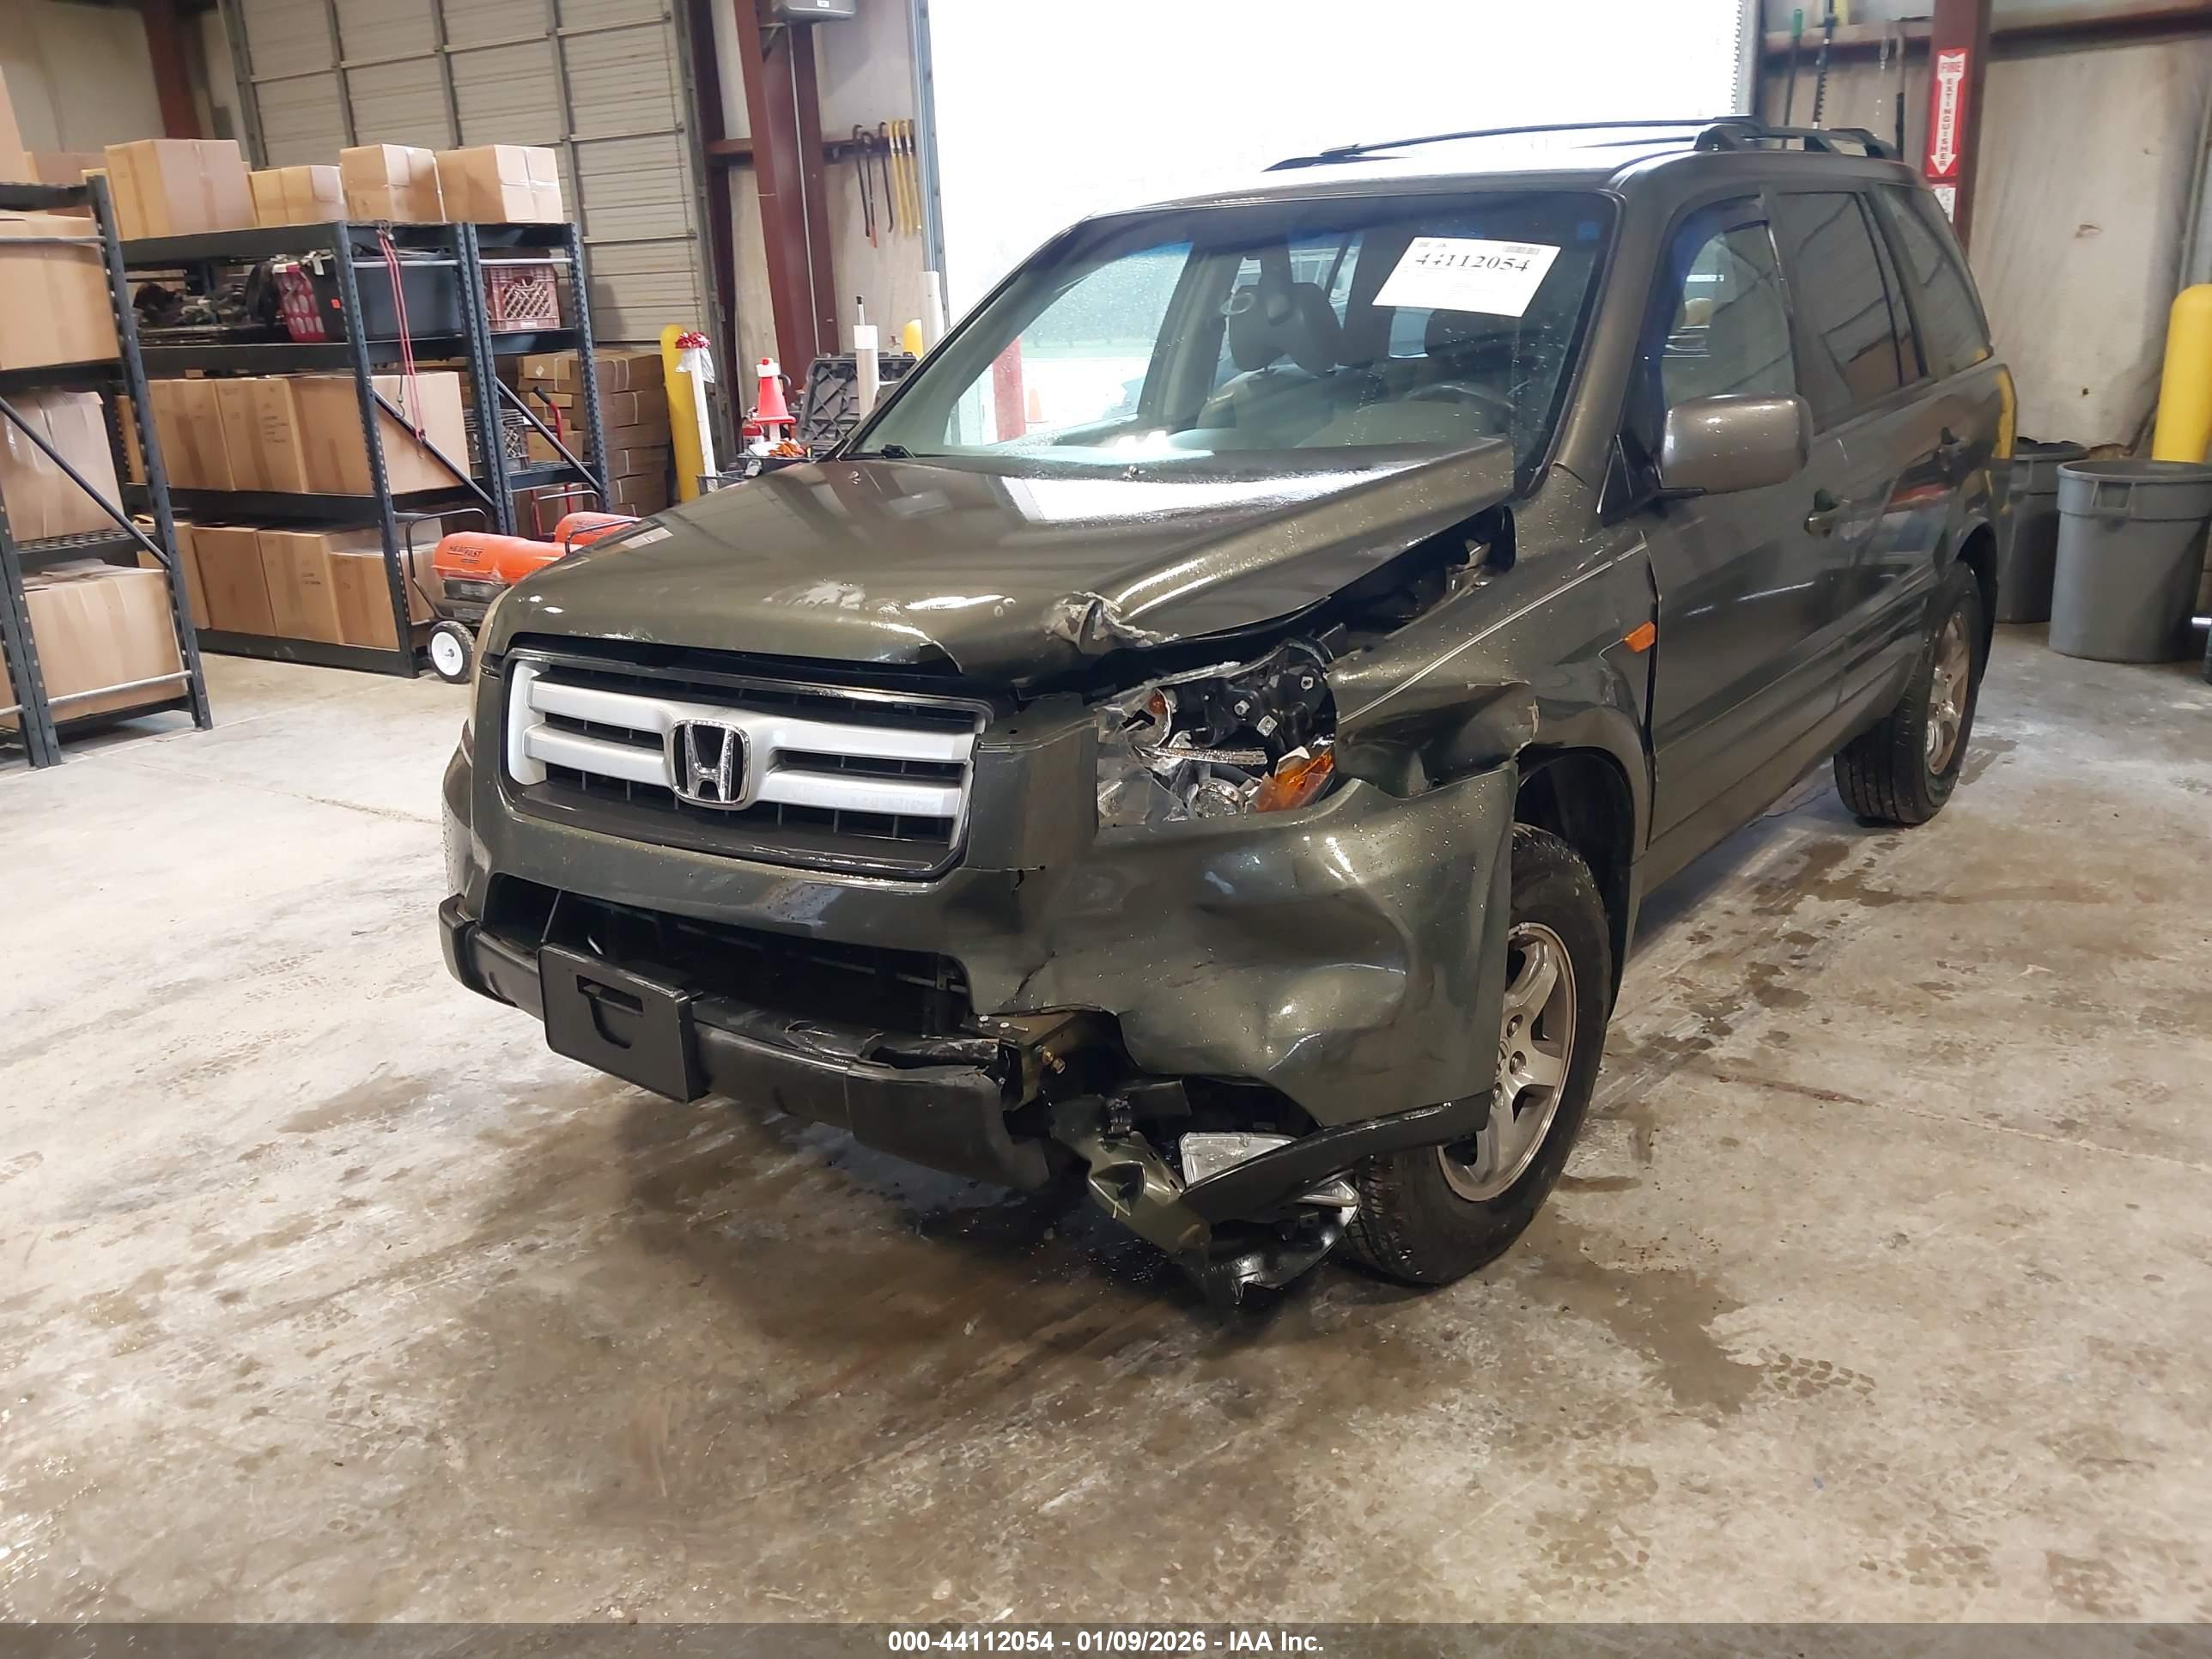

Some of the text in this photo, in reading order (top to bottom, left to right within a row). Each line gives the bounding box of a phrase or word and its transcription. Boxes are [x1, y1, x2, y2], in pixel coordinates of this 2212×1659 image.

[1941, 61, 1962, 73] FIRE
[1939, 78, 1953, 167] EXTINGUISHER
[1415, 252, 1530, 272] 44112054
